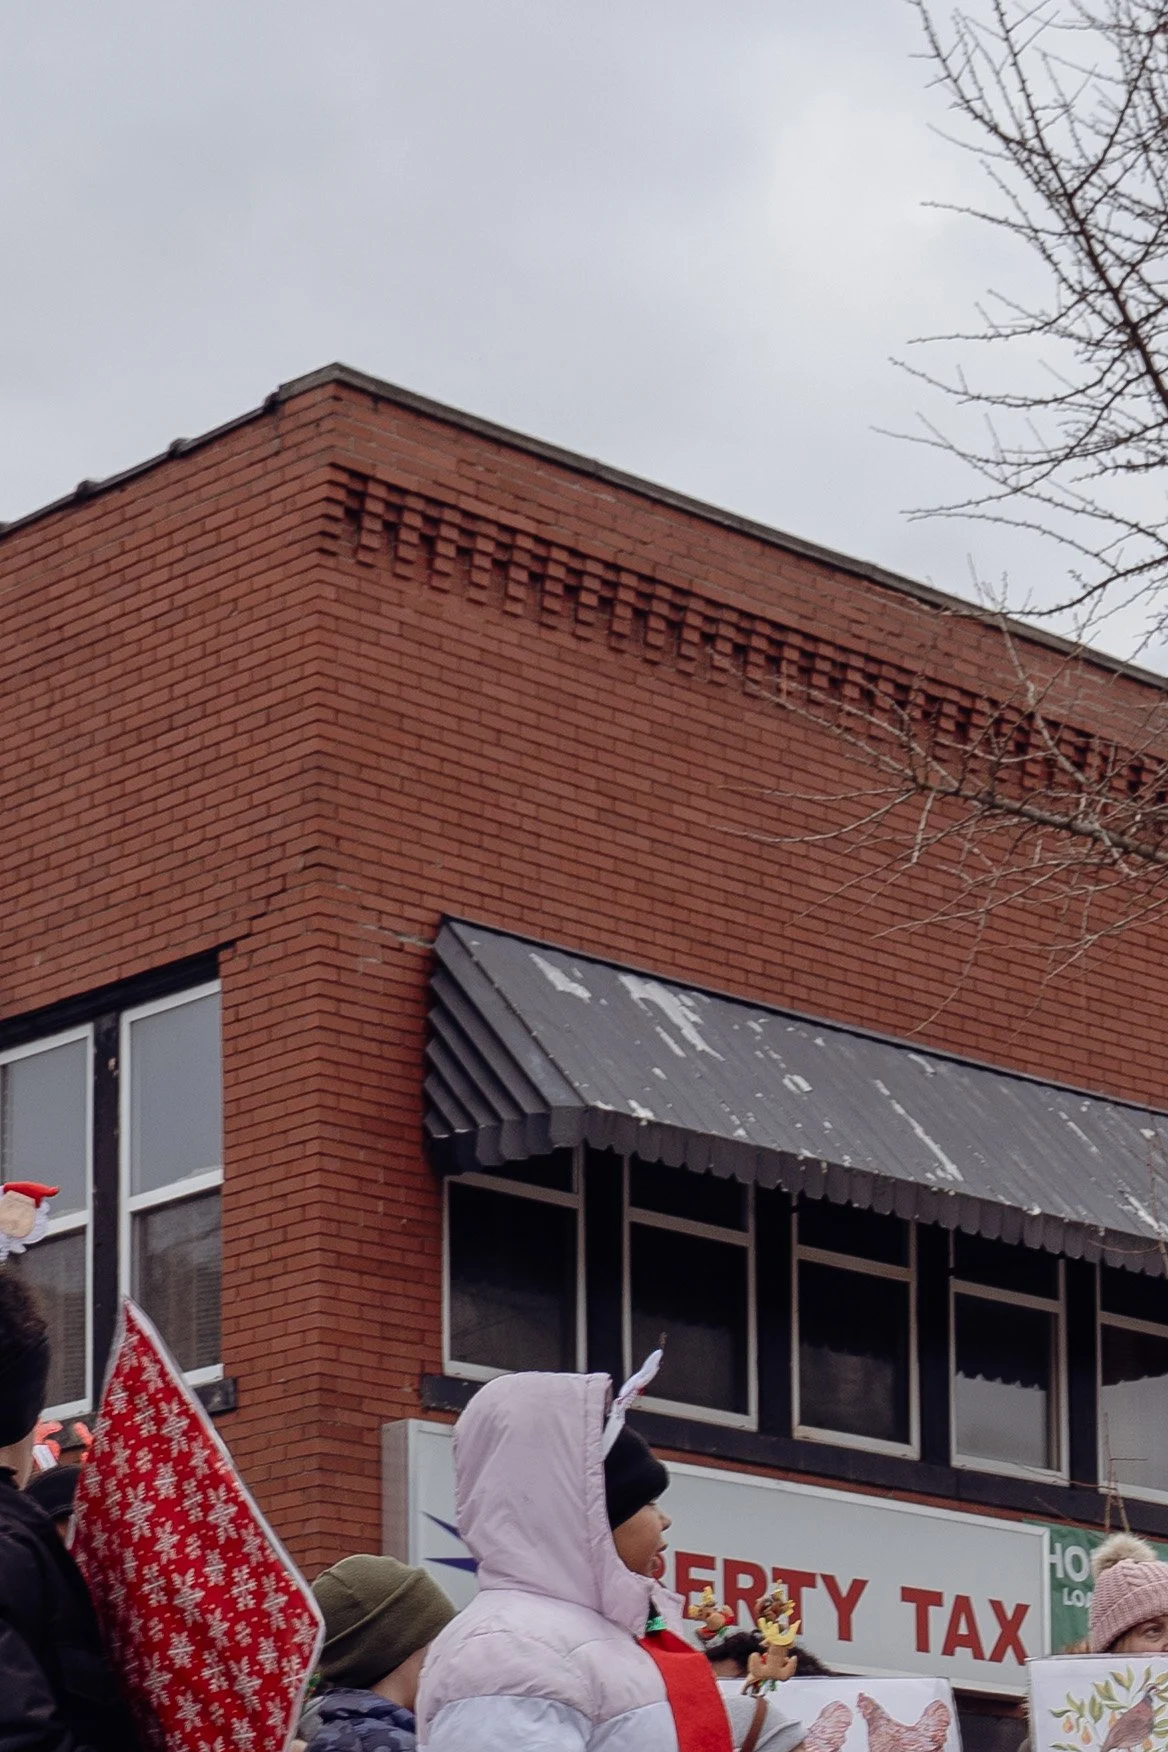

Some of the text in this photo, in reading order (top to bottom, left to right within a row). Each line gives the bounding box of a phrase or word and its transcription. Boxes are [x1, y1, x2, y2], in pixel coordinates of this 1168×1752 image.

[1048, 1543, 1090, 1582] HO
[653, 1551, 1031, 1666] ERTY TAX
